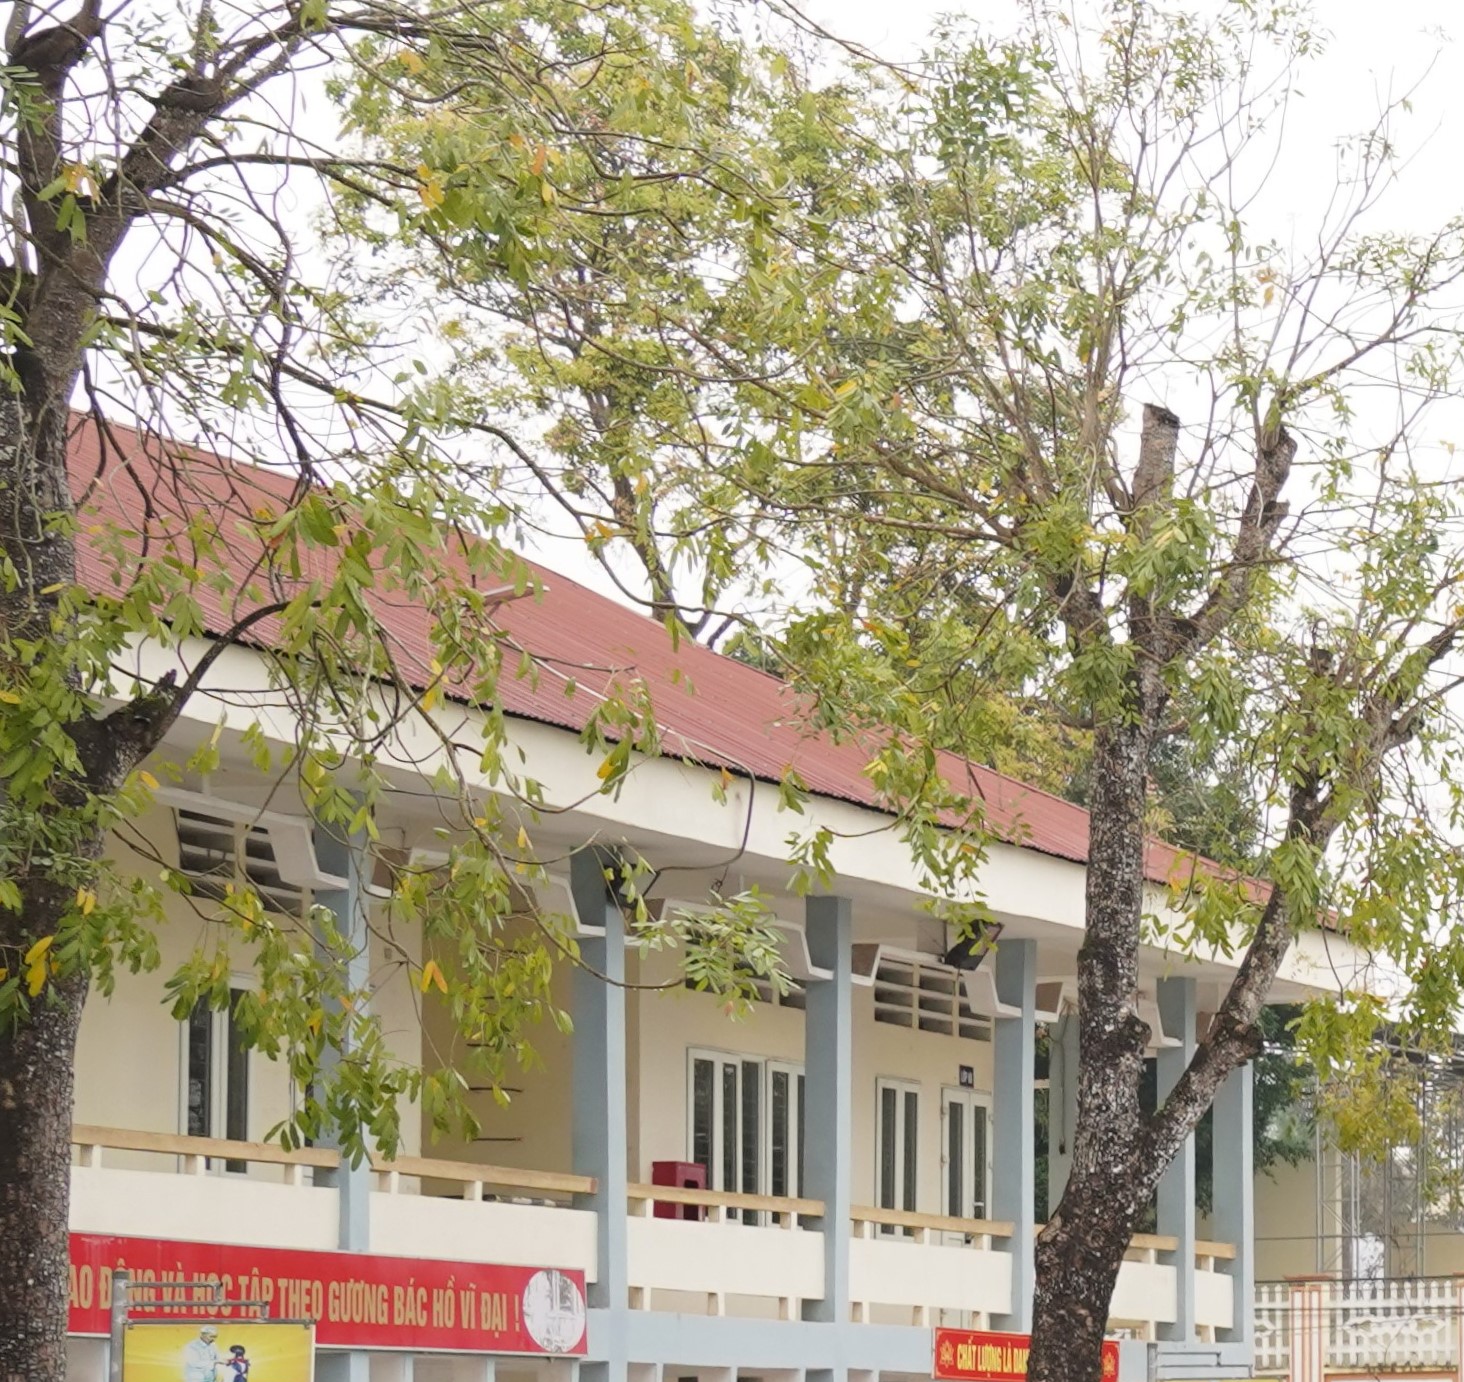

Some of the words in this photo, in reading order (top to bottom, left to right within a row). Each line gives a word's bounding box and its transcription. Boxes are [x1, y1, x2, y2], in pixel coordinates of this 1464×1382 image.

[67, 1264, 94, 1310] AO
[162, 1261, 186, 1314] VÀ
[193, 1271, 233, 1321] HỌC
[278, 1277, 323, 1322] THEO
[328, 1278, 389, 1325] GƯƠNG
[394, 1278, 427, 1328] BÁC
[433, 1275, 456, 1329] HỒ
[460, 1284, 476, 1330] VĨ
[481, 1292, 508, 1339] ĐẠI
[515, 1294, 520, 1333] !
[957, 1336, 977, 1371] CHẤT
[977, 1342, 1002, 1378] LƯỢNG
[1003, 1341, 1013, 1373] LÀ
